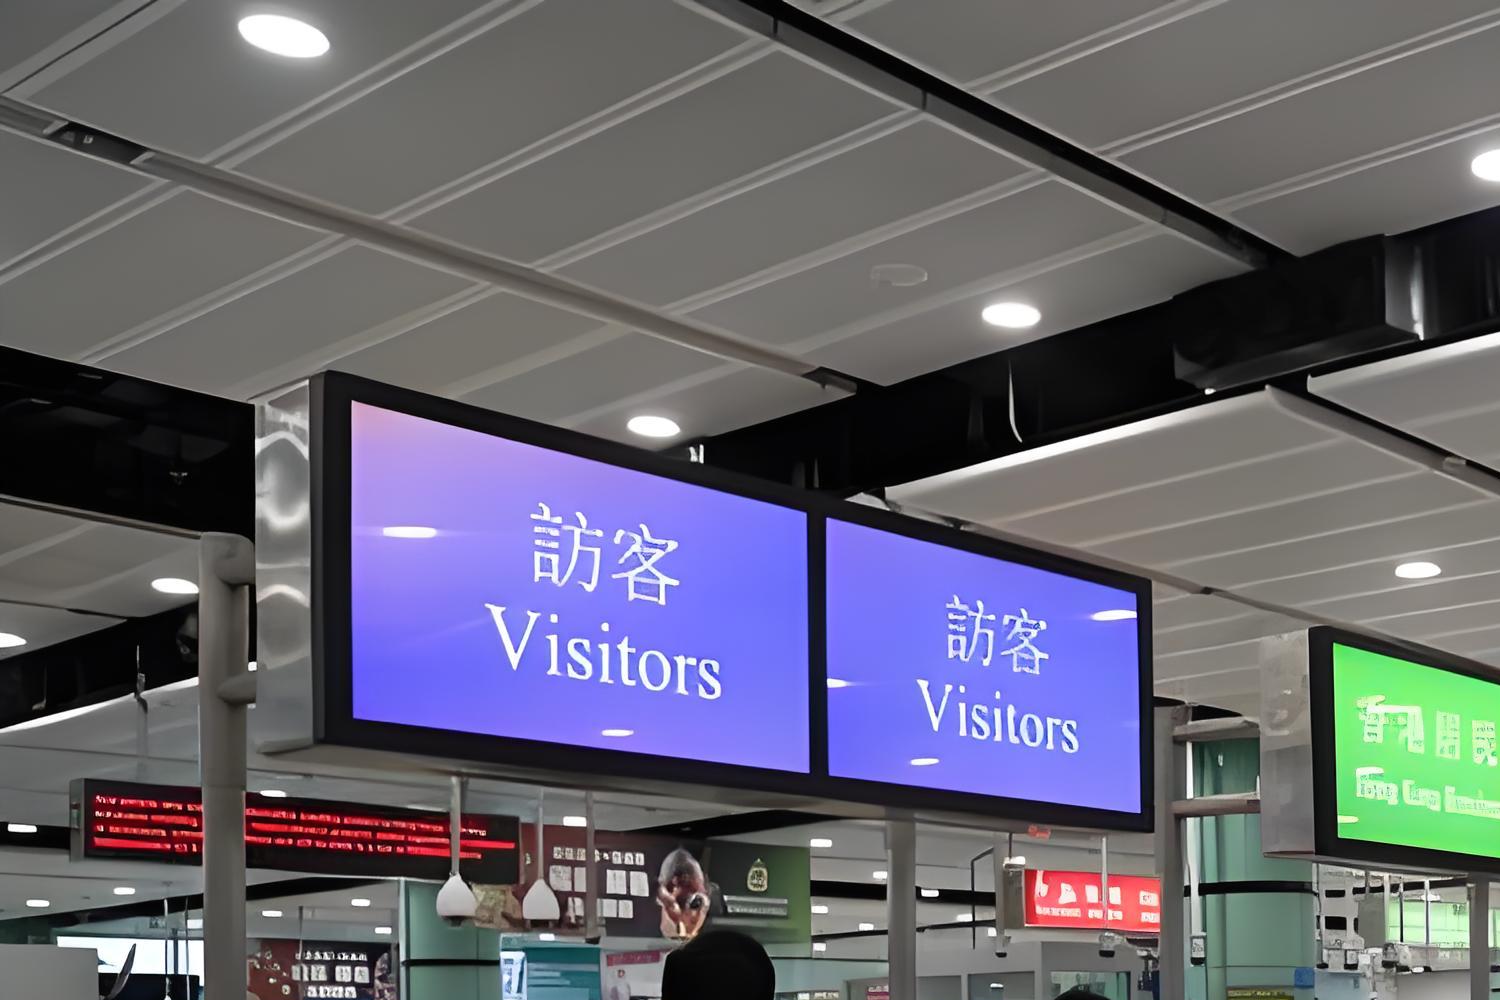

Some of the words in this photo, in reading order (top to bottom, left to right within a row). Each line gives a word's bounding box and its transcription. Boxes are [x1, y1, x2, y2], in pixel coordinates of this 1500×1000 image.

[530, 502, 680, 605] 訪客
[484, 603, 722, 700] Visitors
[946, 594, 1049, 675] 訪客
[916, 679, 1080, 753] Visitors
